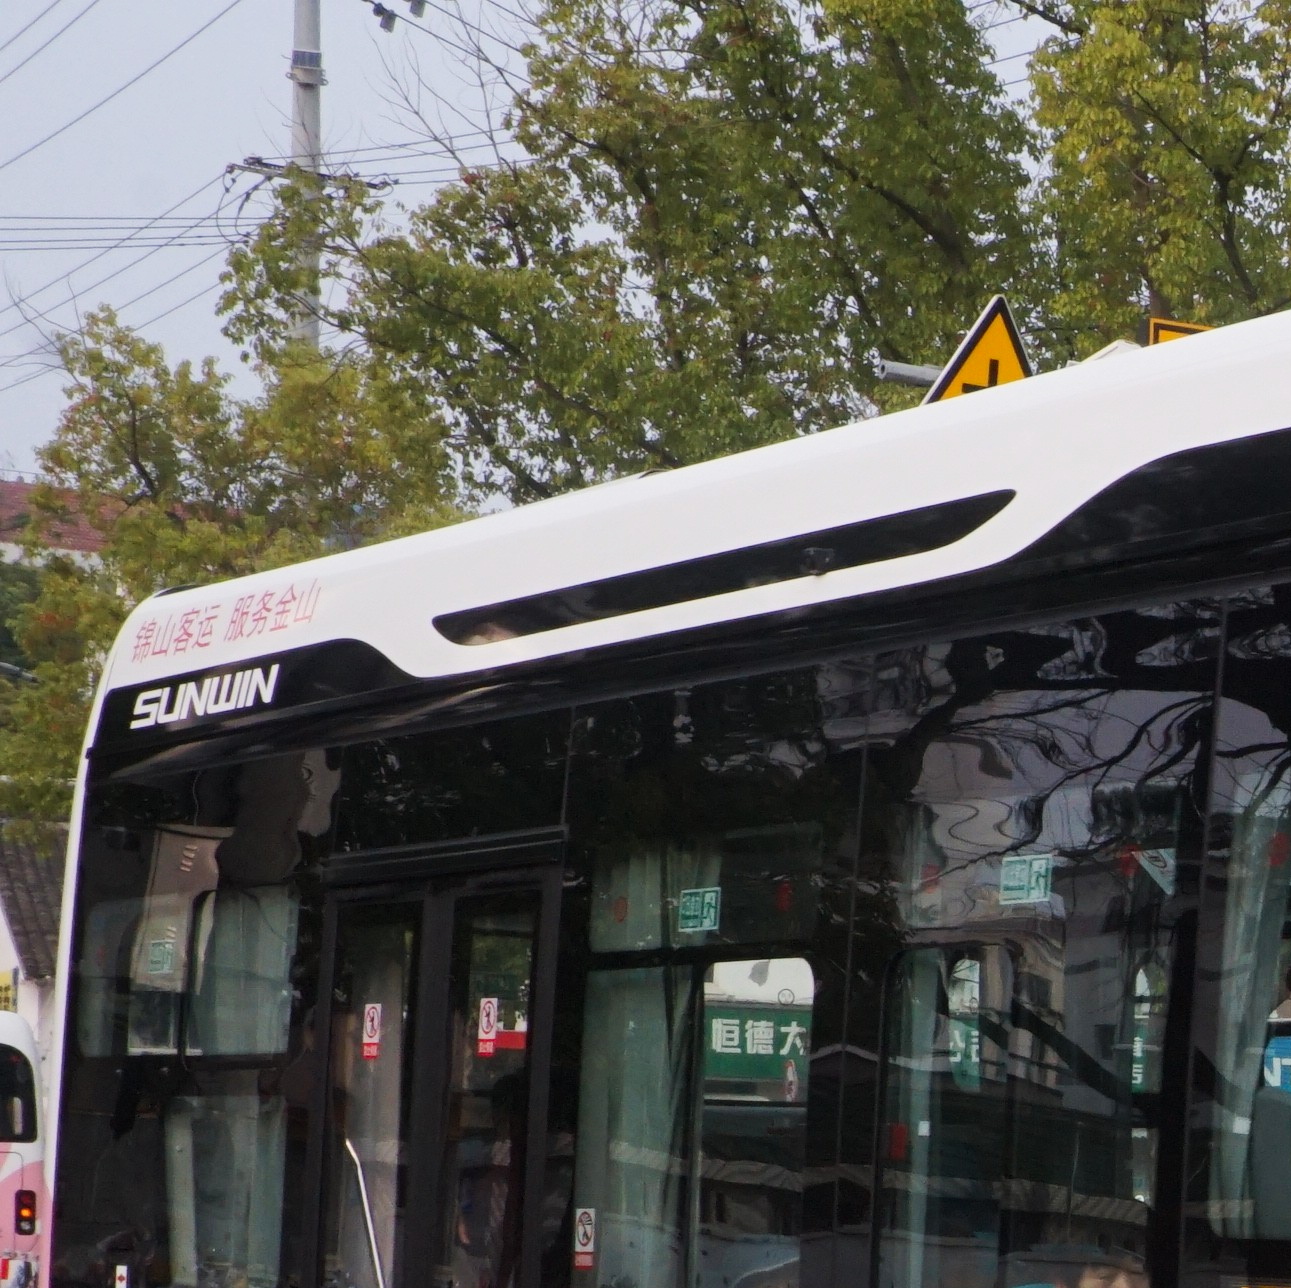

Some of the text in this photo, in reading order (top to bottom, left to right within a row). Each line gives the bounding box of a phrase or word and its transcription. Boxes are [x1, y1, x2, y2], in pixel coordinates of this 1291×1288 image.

[131, 578, 322, 663] 锦山客运 服务金山
[130, 664, 280, 730] SUNWIN
